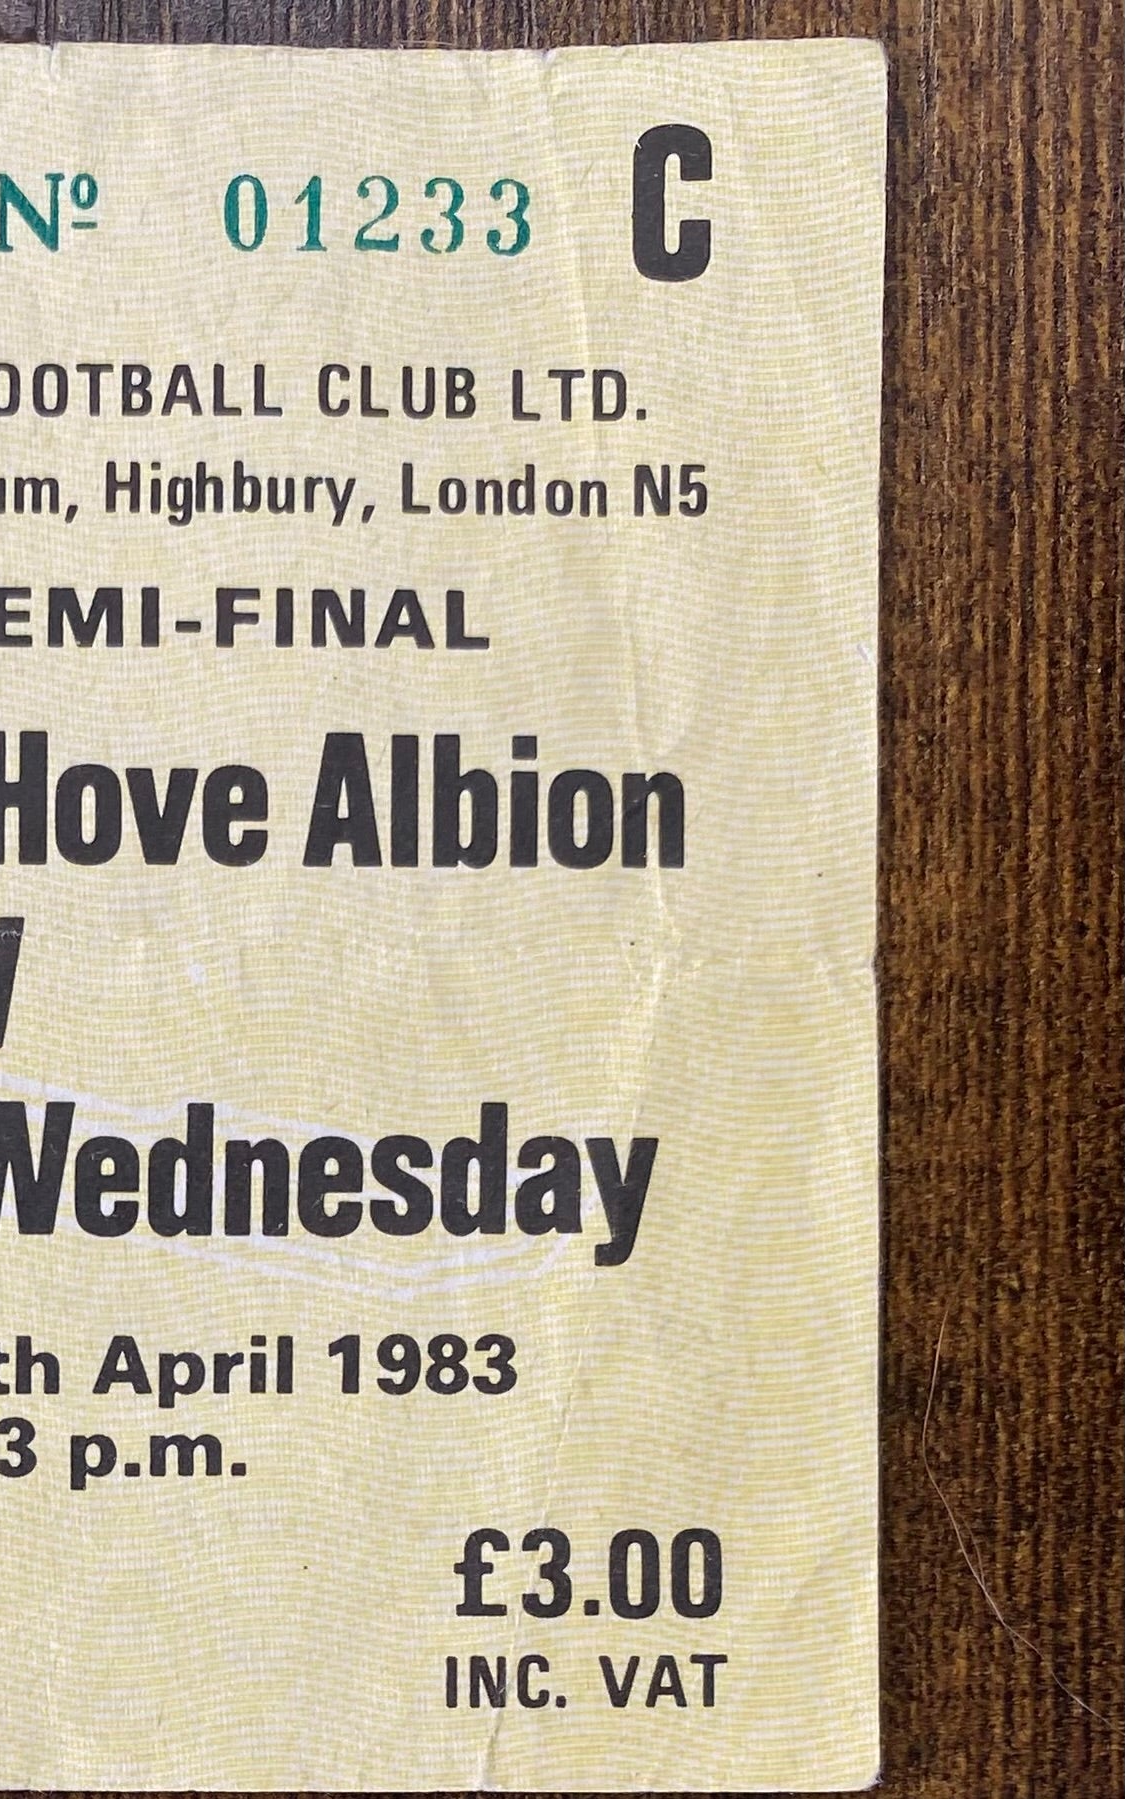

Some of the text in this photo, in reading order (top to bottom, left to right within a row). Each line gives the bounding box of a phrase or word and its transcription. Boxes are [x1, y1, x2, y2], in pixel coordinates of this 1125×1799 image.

[223, 174, 531, 257] 01233
[631, 123, 713, 283] C
[318, 363, 477, 420] CLUB
[511, 368, 647, 422] LTD.
[105, 460, 375, 527] Highbury,
[401, 462, 608, 518] London
[634, 463, 708, 517] N5
[302, 731, 685, 870] Albion
[92, 1334, 294, 1409] April
[328, 1333, 518, 1396] 1983
[70, 1433, 247, 1491] p.m.
[453, 1527, 723, 1620] £3.00
[445, 1653, 728, 1709] INC. VAT
